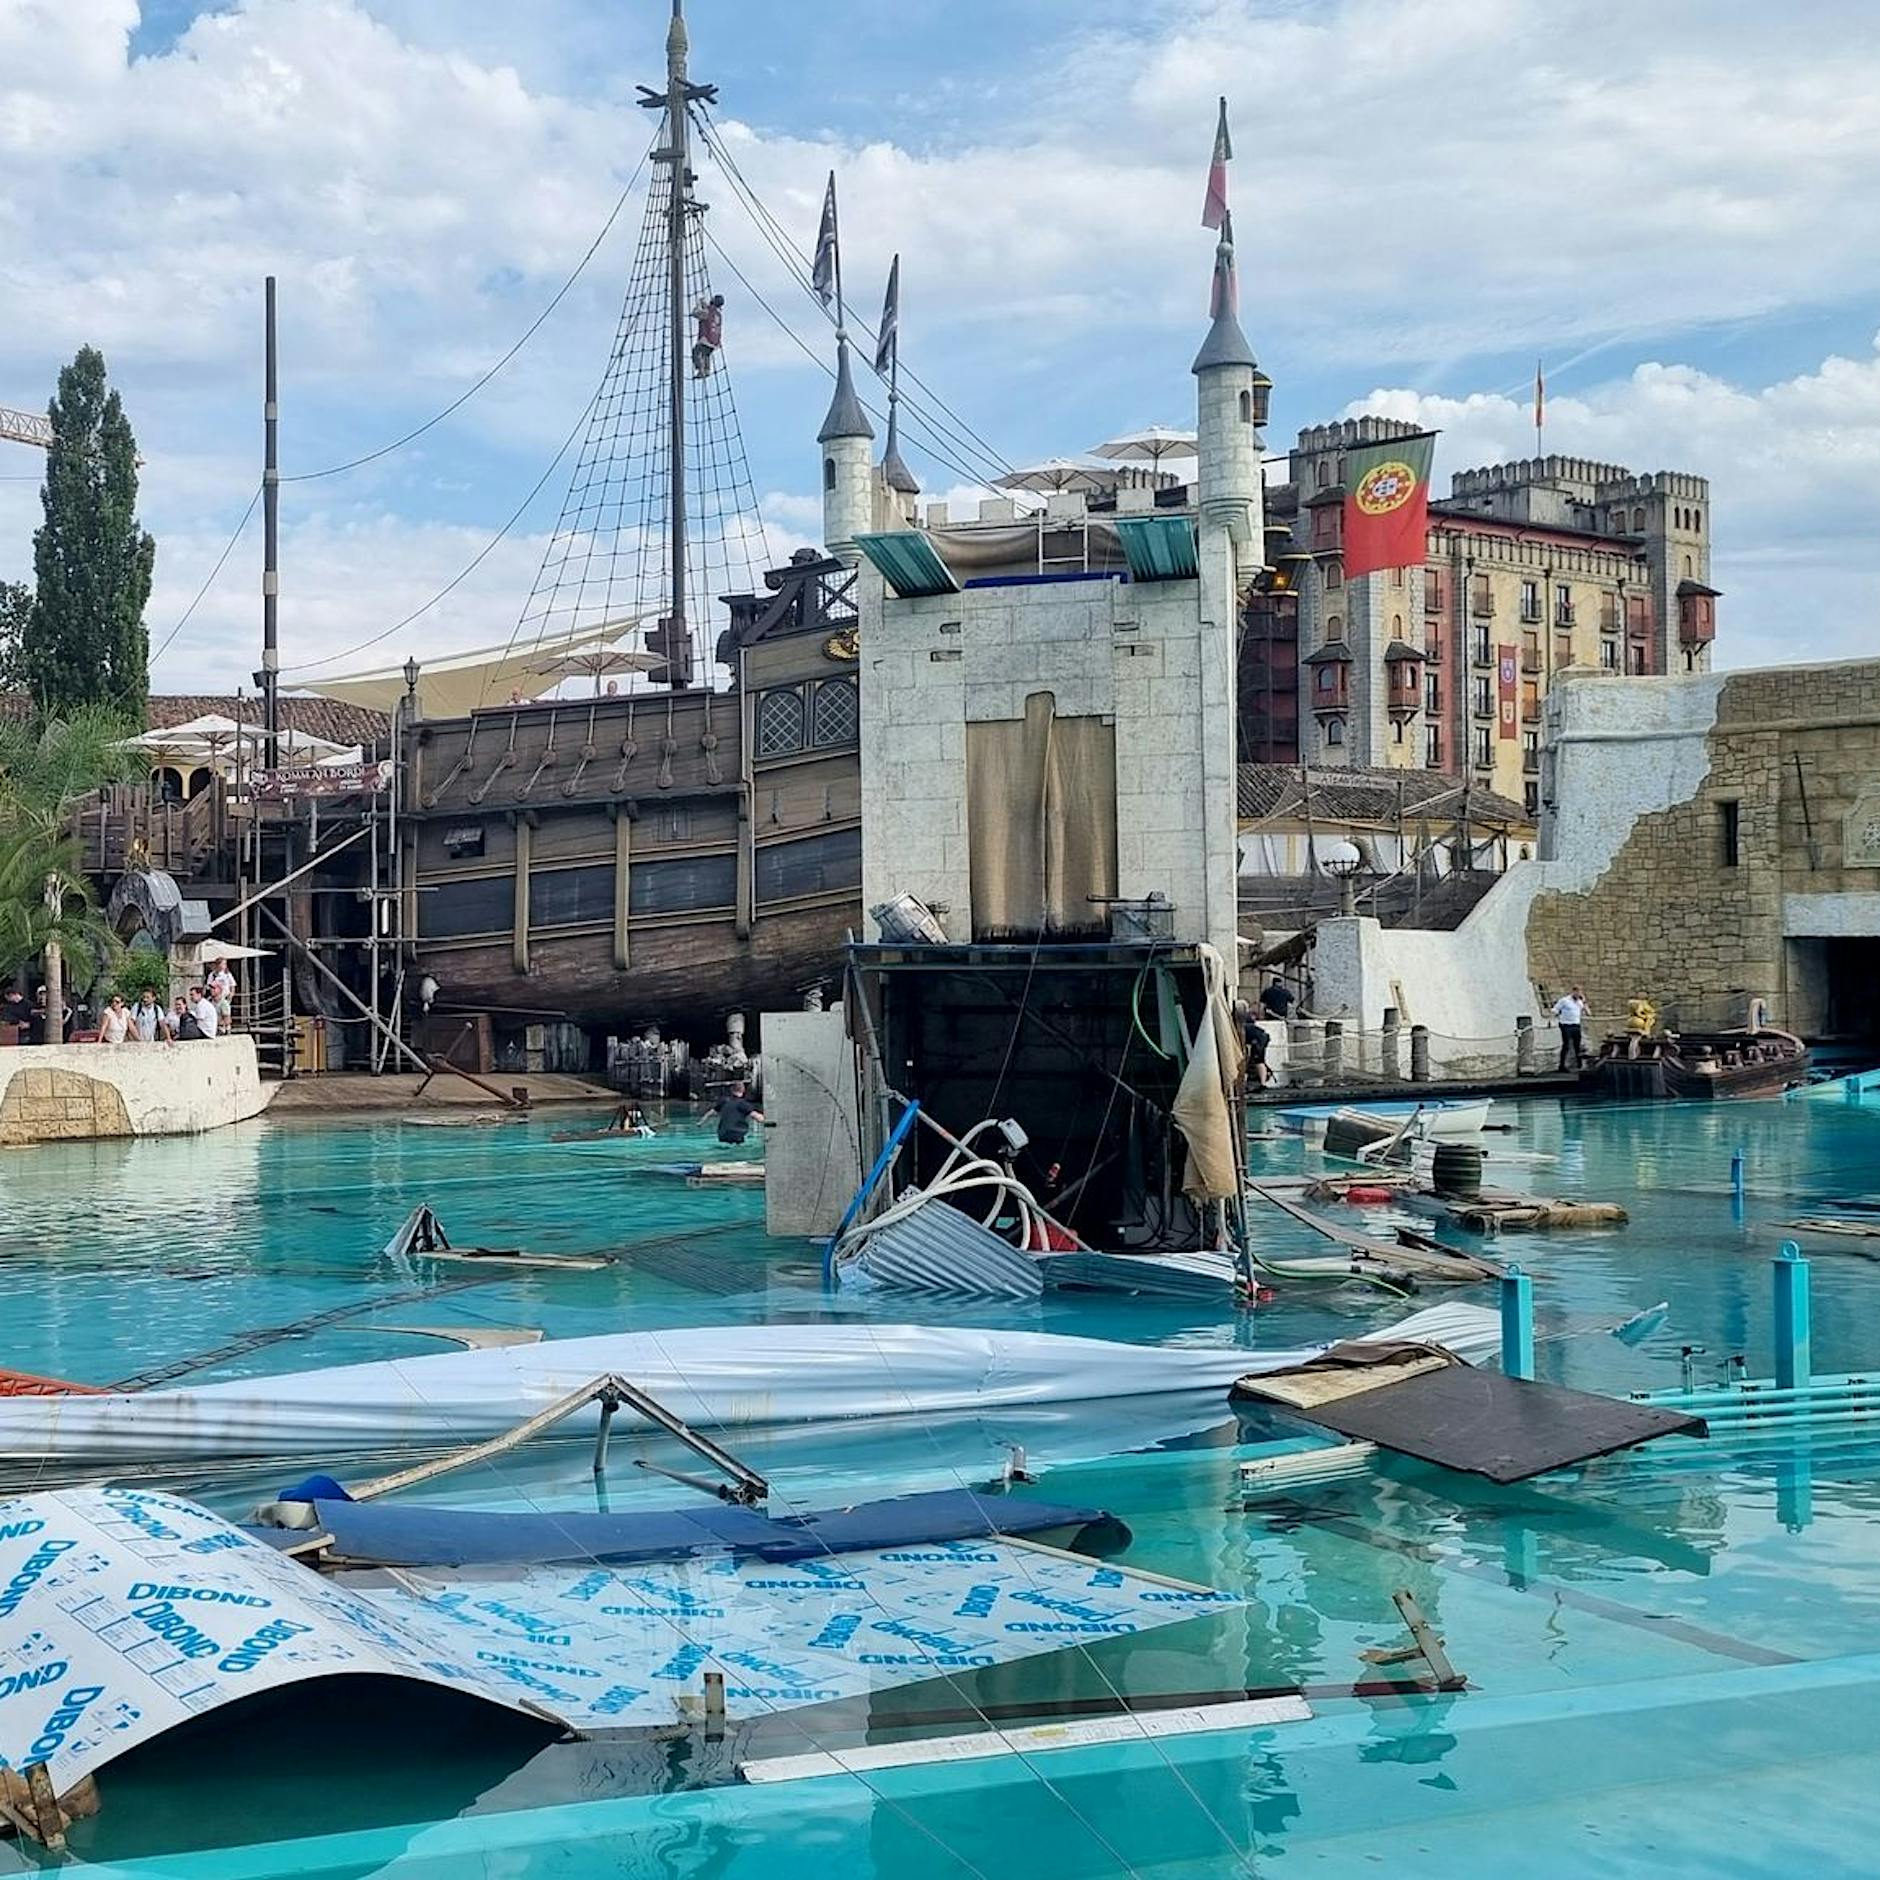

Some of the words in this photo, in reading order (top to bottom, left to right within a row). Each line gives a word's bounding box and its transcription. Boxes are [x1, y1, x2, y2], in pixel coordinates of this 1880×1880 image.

[880, 1553, 998, 1562] DIBOND
[127, 1582, 272, 1608] DIBOND
[745, 1580, 865, 1589] DIBOND
[601, 1606, 724, 1618] DIBOND
[1009, 1592, 1112, 1622] DIBOND
[131, 1601, 220, 1659] DIBOND
[871, 1621, 972, 1654] DIBOND
[1005, 1622, 1136, 1633] DIBOND
[217, 1618, 313, 1672] DIBOND
[476, 1651, 602, 1678] DIBOND
[719, 1652, 822, 1687] DIBOND
[859, 1654, 994, 1666] DIBOND
[702, 1686, 840, 1699] DIBON
